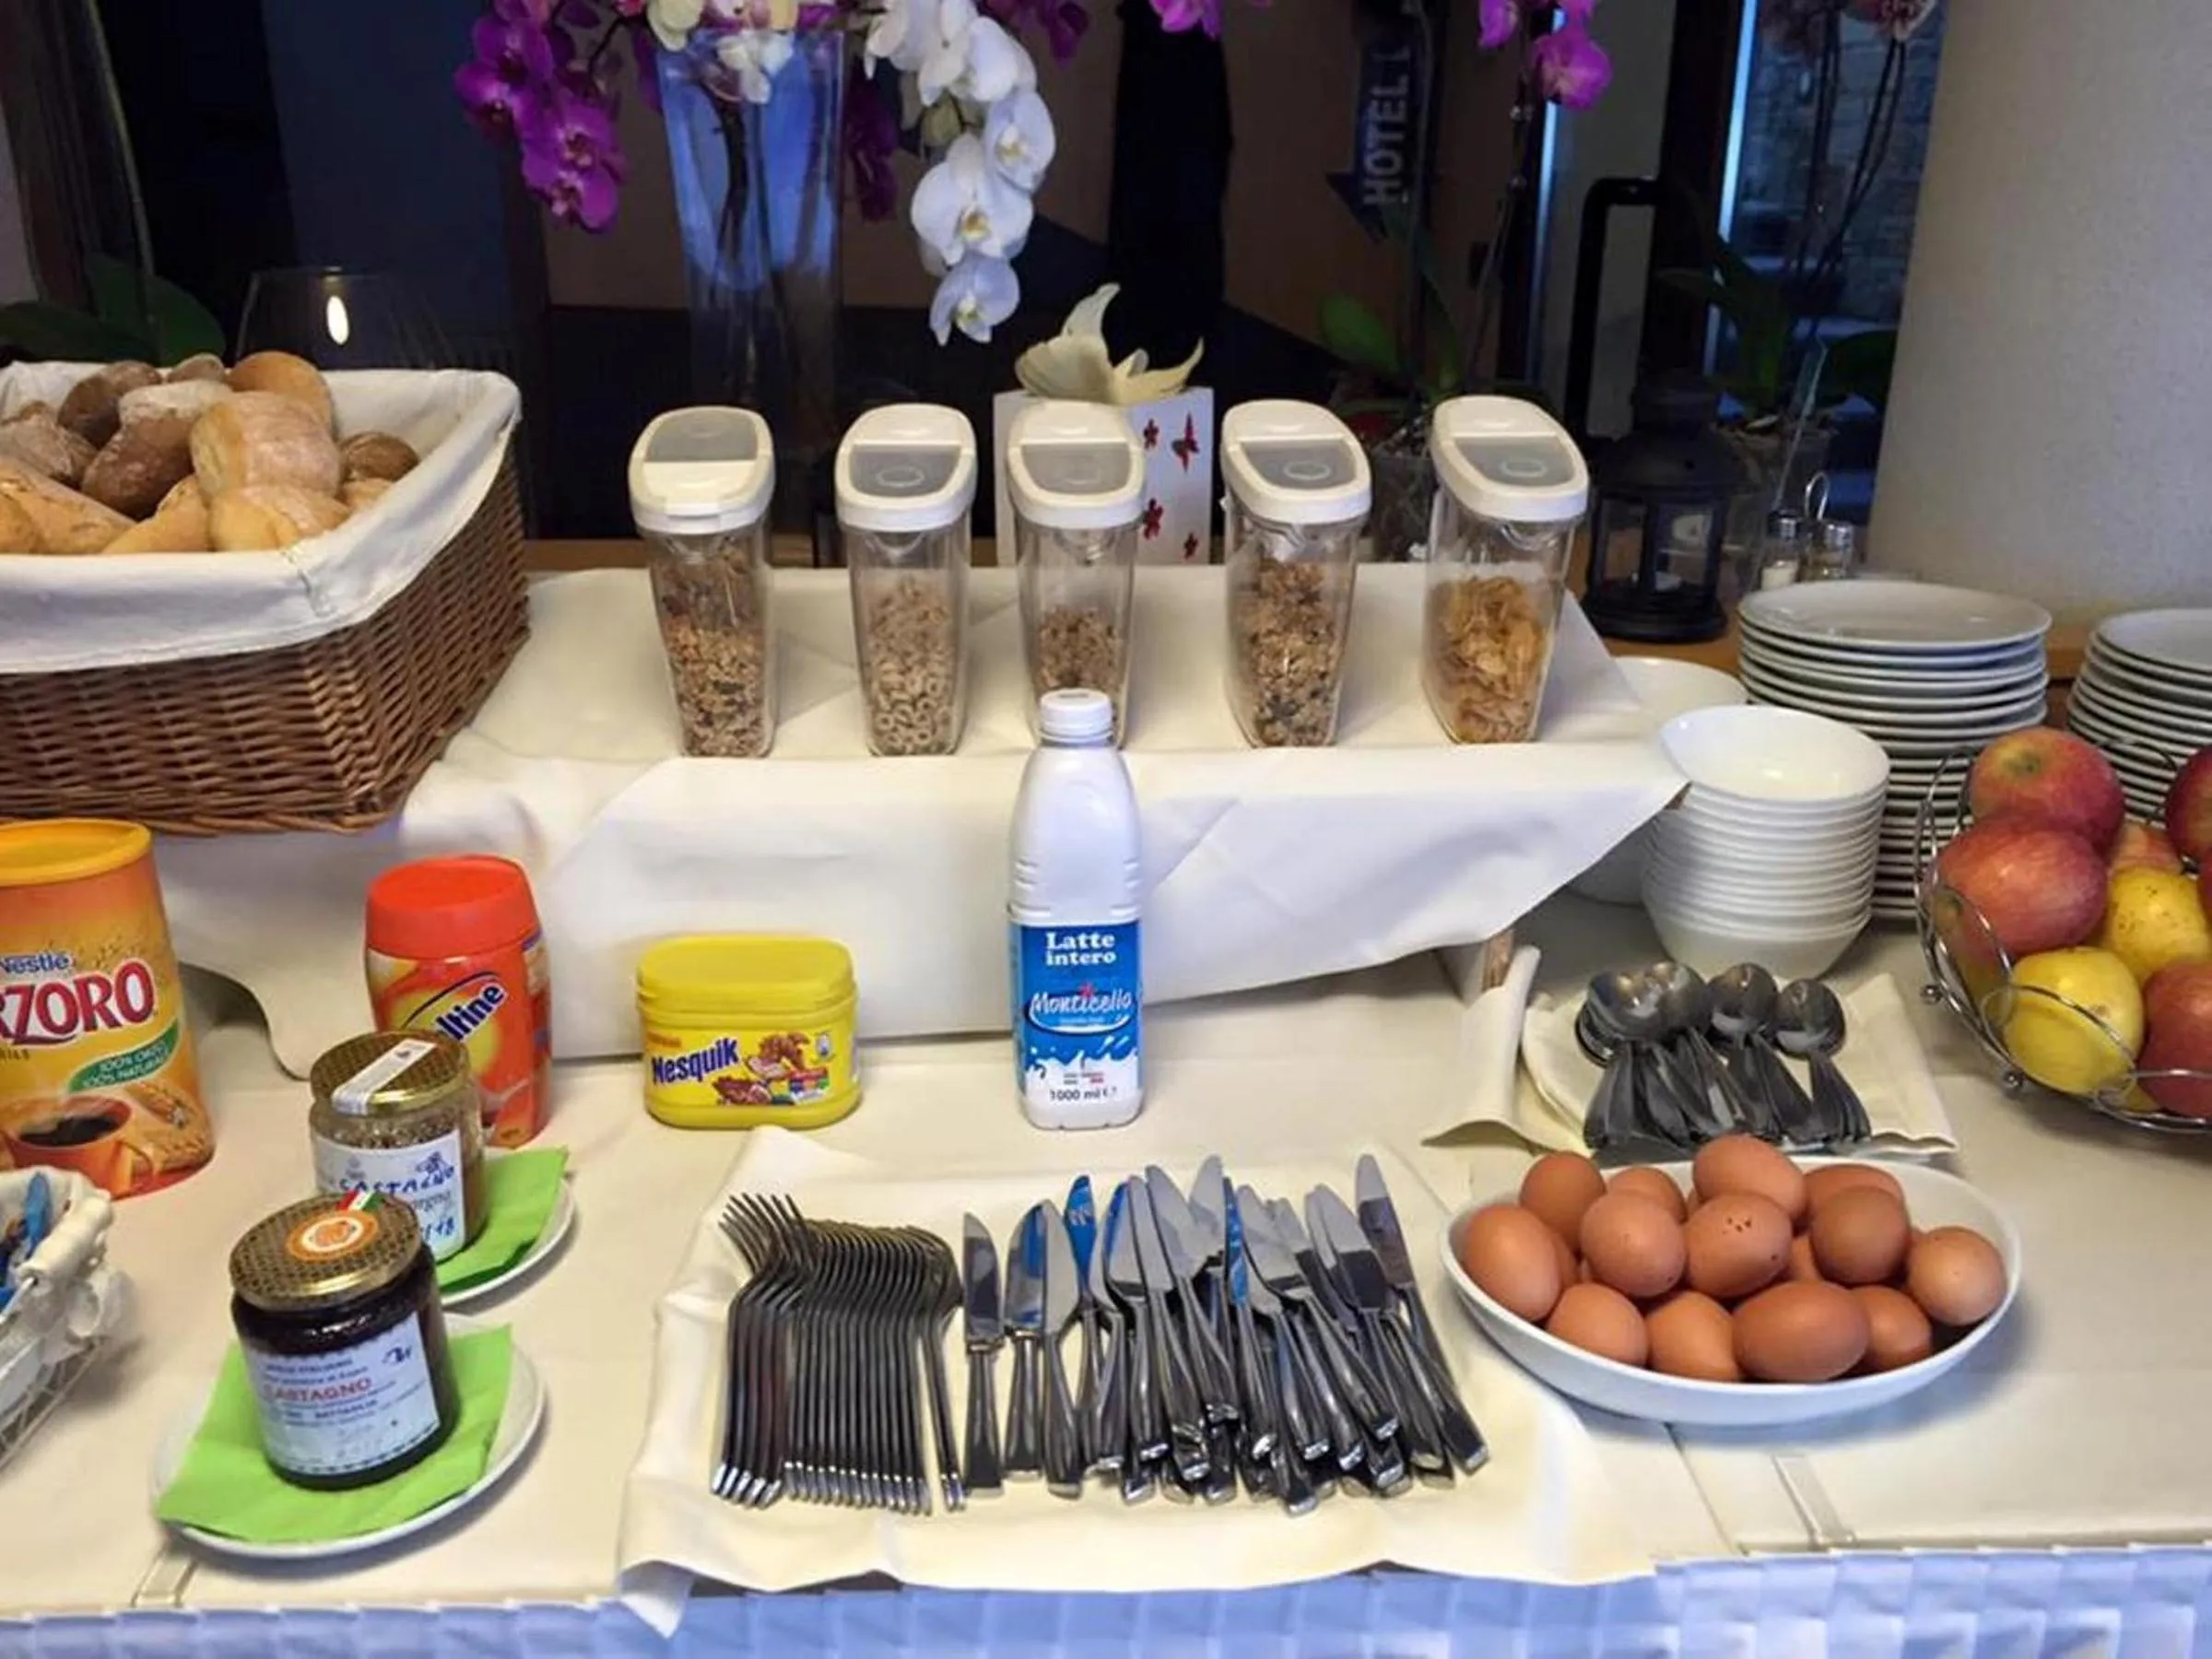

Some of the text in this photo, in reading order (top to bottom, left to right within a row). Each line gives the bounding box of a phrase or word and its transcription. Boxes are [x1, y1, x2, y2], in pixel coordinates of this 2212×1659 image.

[1362, 75, 1409, 206] HOTEL
[1045, 932, 1115, 949] Latte
[1045, 951, 1117, 966] intero
[0, 960, 155, 1045] ZORO
[436, 986, 504, 1041] ltine
[651, 1038, 738, 1085] Nesquik
[1050, 1088, 1080, 1101] 1000
